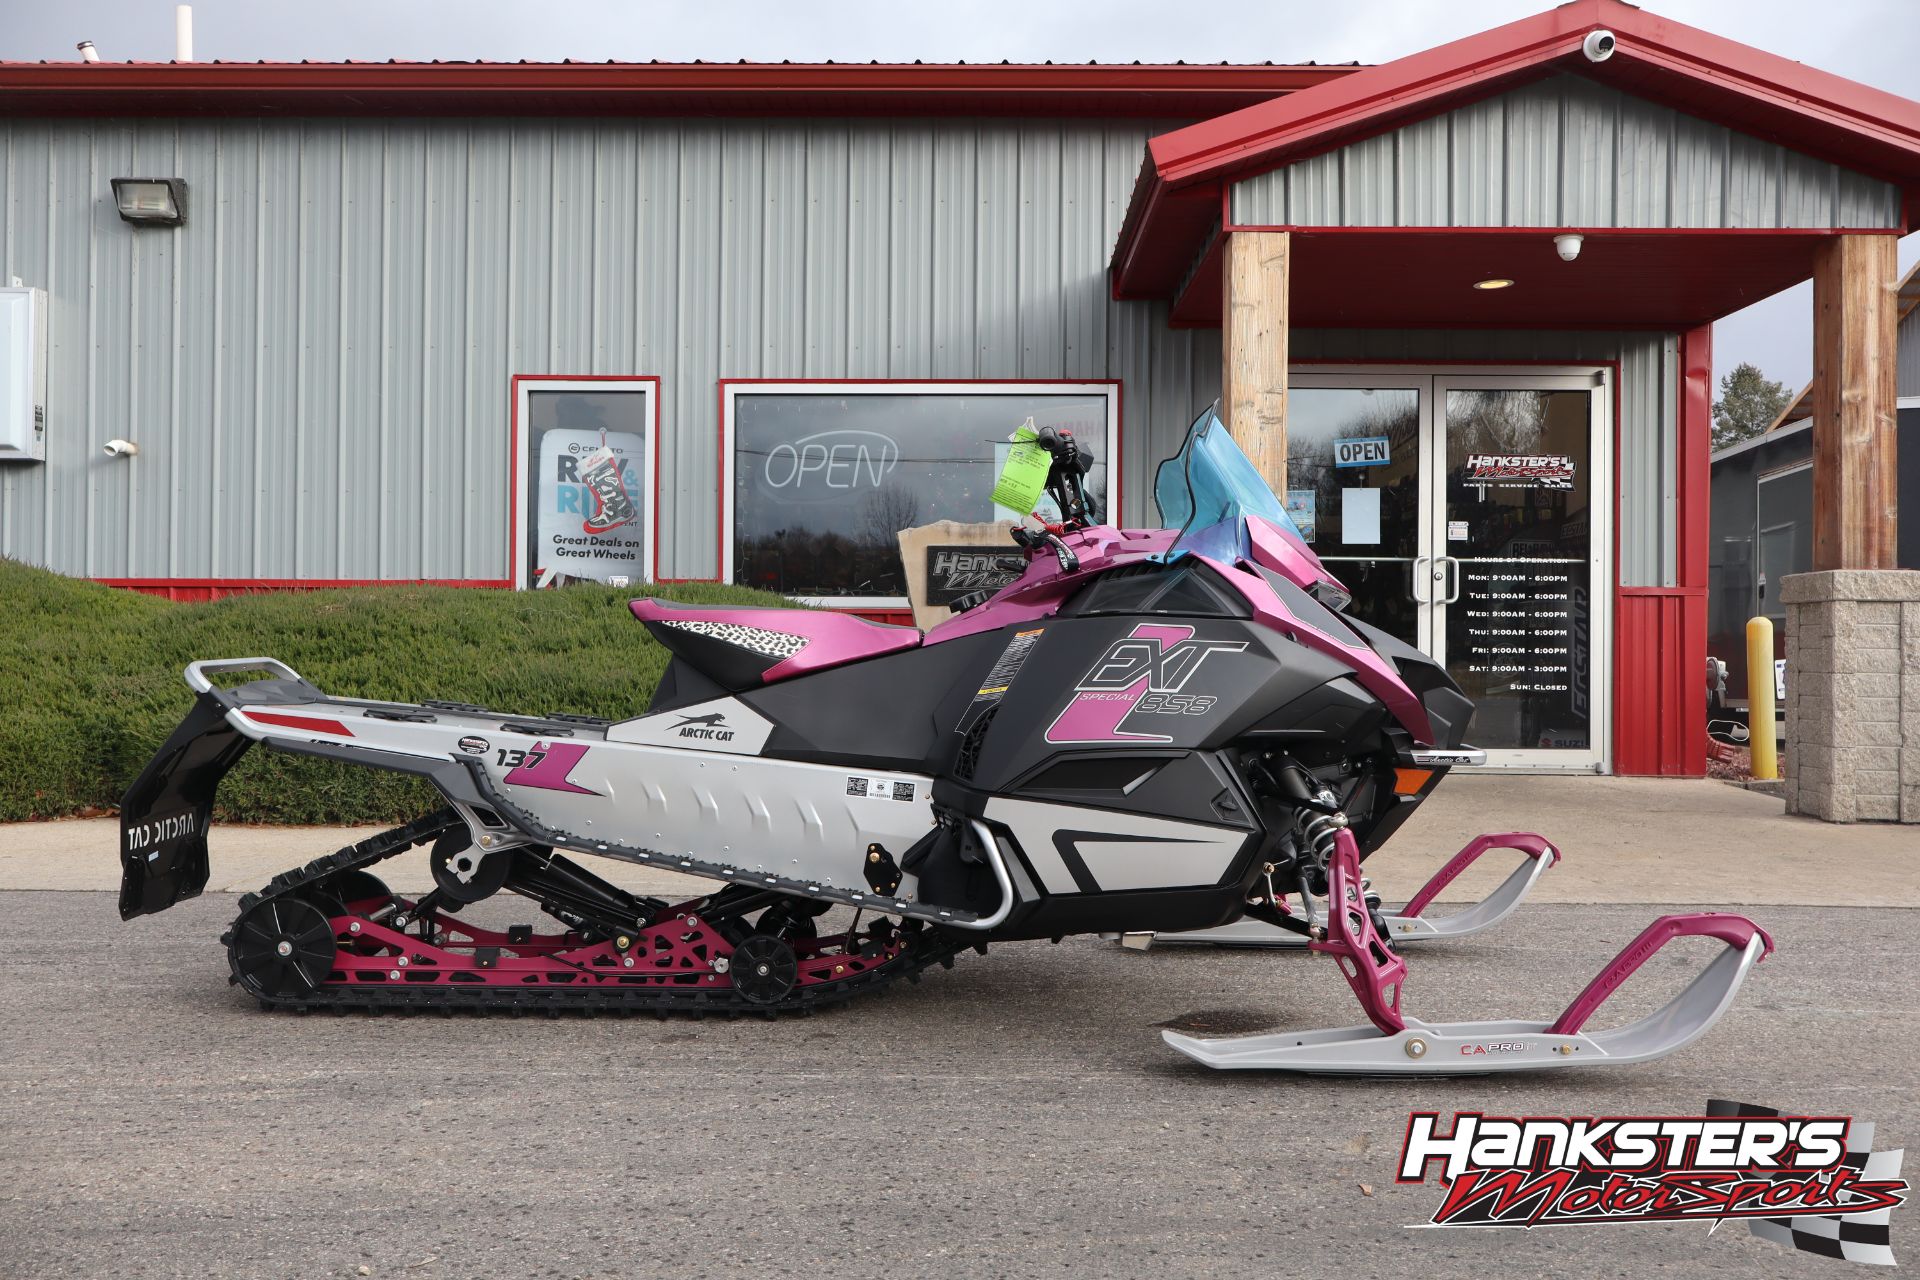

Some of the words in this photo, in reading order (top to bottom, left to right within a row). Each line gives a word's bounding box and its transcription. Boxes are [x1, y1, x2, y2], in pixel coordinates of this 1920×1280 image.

[582, 446, 623, 454] CFTO
[1339, 442, 1385, 461] OPEN
[765, 444, 887, 488] OPEN
[553, 534, 587, 545] Great
[590, 535, 623, 547] Deals
[625, 540, 639, 548] on
[556, 547, 591, 557] Great
[593, 549, 636, 560] Wheels
[944, 571, 1019, 589] Moto
[1074, 639, 1249, 692] EXT
[1079, 693, 1137, 701] SPECIAL
[1135, 694, 1217, 715] 858
[679, 727, 714, 740] ARCTIC
[716, 730, 735, 742] CAT
[1554, 739, 1584, 747] SUZ
[496, 749, 547, 769] 137
